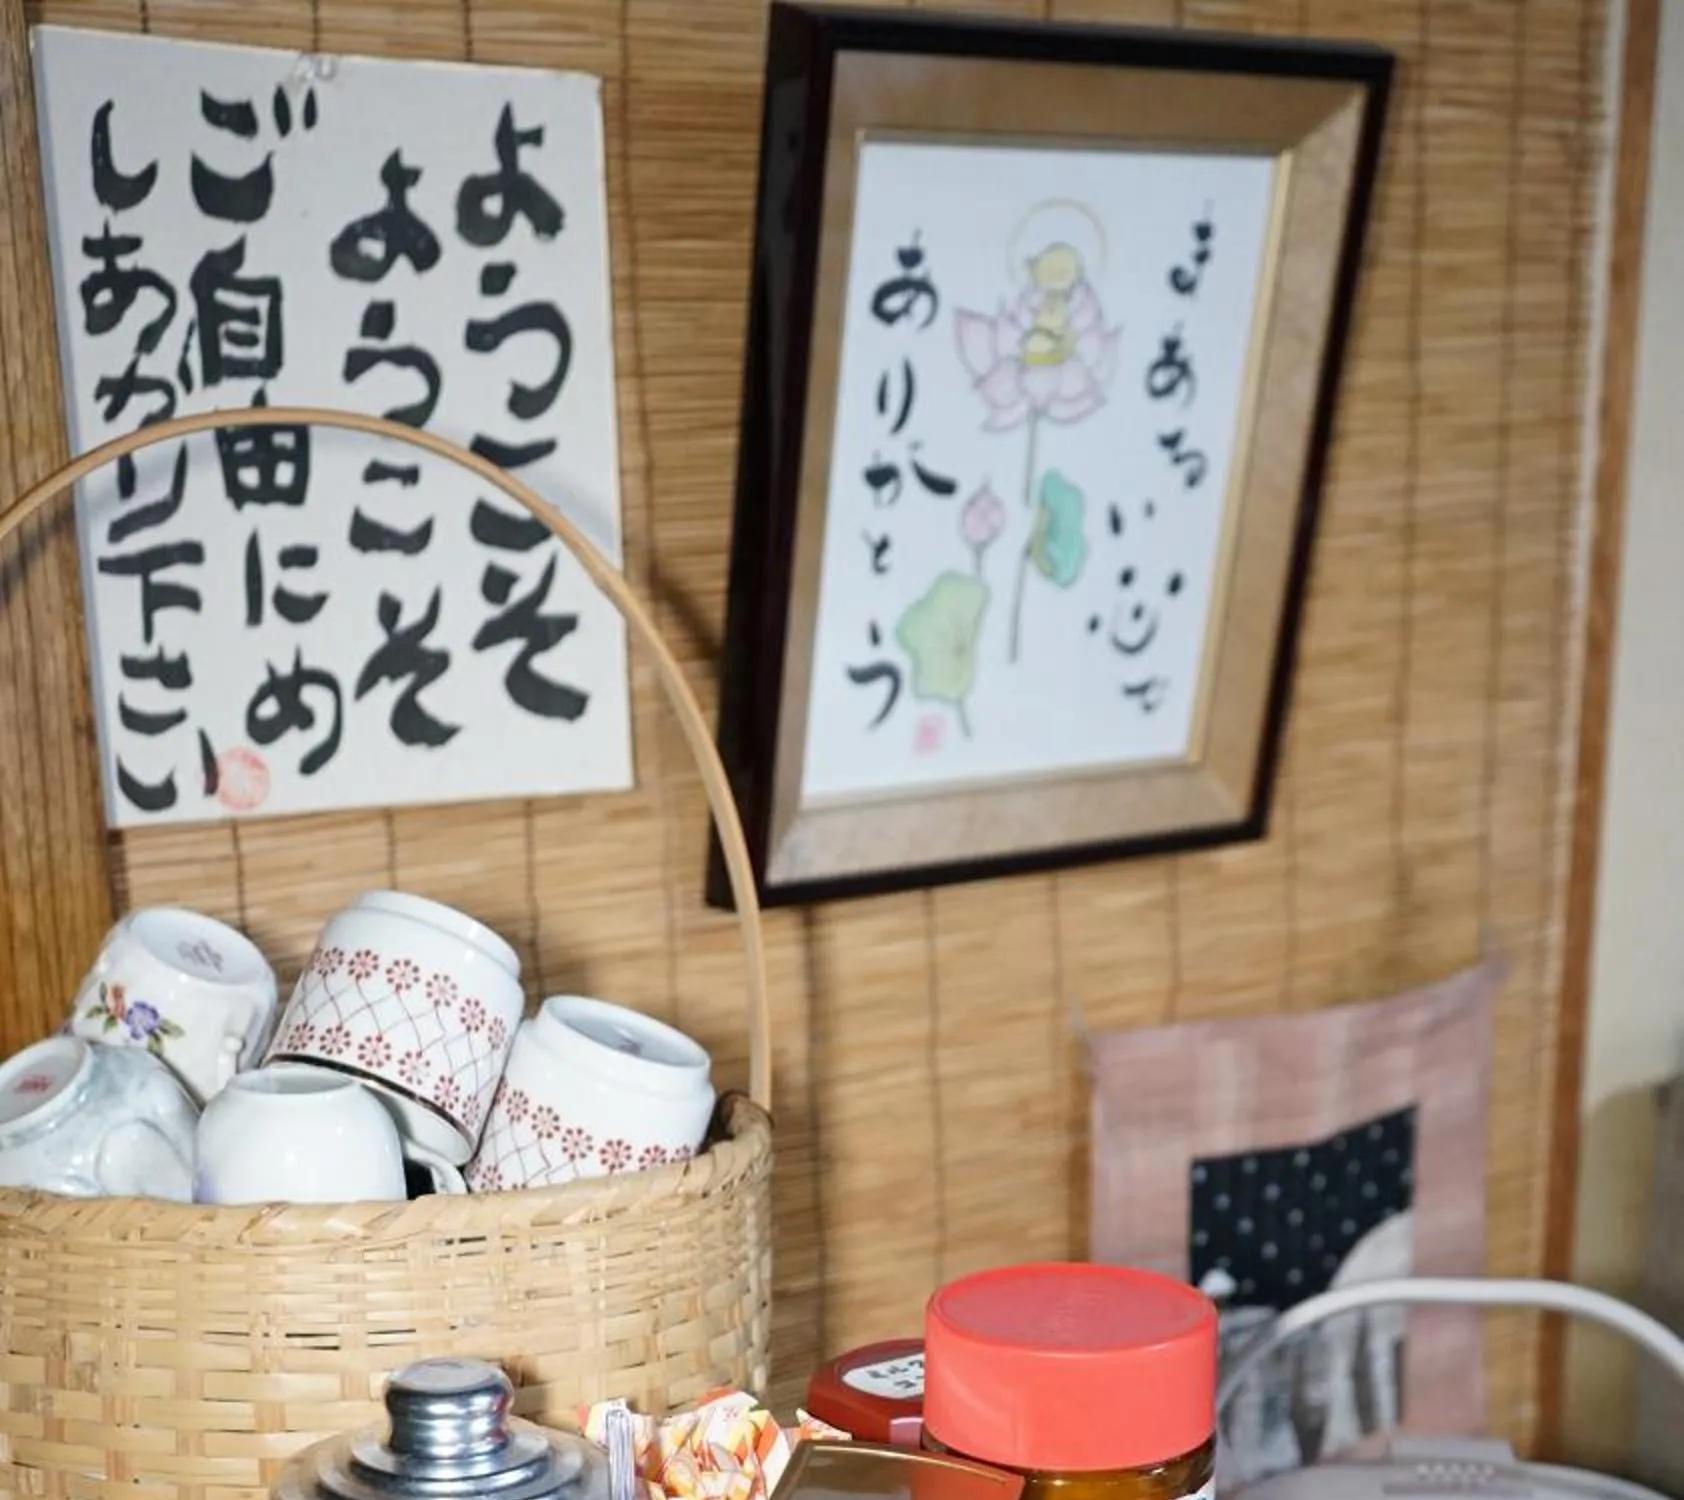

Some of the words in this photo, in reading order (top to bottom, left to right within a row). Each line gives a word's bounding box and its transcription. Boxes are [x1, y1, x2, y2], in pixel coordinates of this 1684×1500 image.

[330, 148, 463, 747] ようこそ
[456, 101, 591, 722] ようこそ
